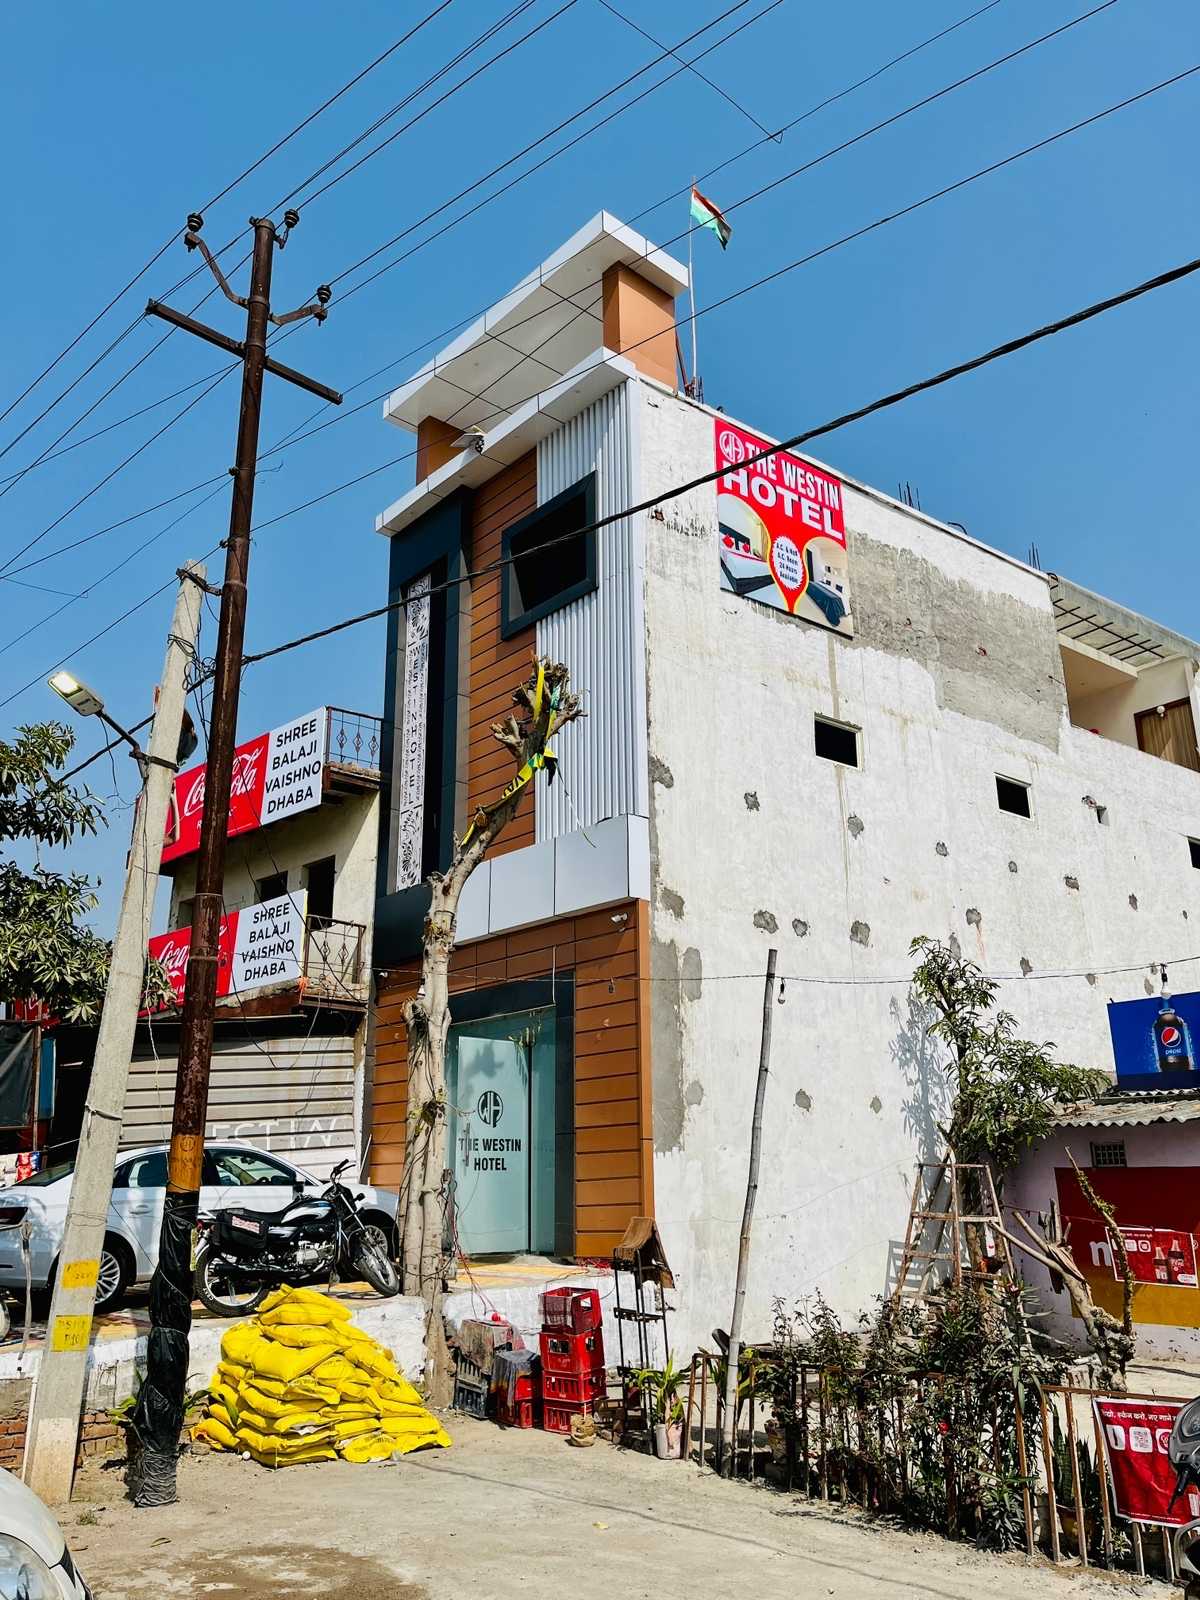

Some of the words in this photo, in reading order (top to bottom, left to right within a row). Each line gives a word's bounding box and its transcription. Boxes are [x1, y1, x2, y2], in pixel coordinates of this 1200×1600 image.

[745, 442, 777, 481] THE
[781, 459, 840, 512] WESTIN
[722, 461, 843, 541] HOTEL
[276, 719, 317, 748] SHREE
[272, 740, 317, 771] BALAJI
[265, 760, 321, 794] VAISHNO
[267, 786, 314, 814] DHABA
[253, 902, 290, 924] SHREE
[249, 921, 290, 944] BALAJI
[241, 939, 295, 964] VAISHNO
[244, 961, 287, 982] DHABA
[482, 1138, 521, 1152] WESTIN
[474, 1157, 507, 1171] HOTEL
